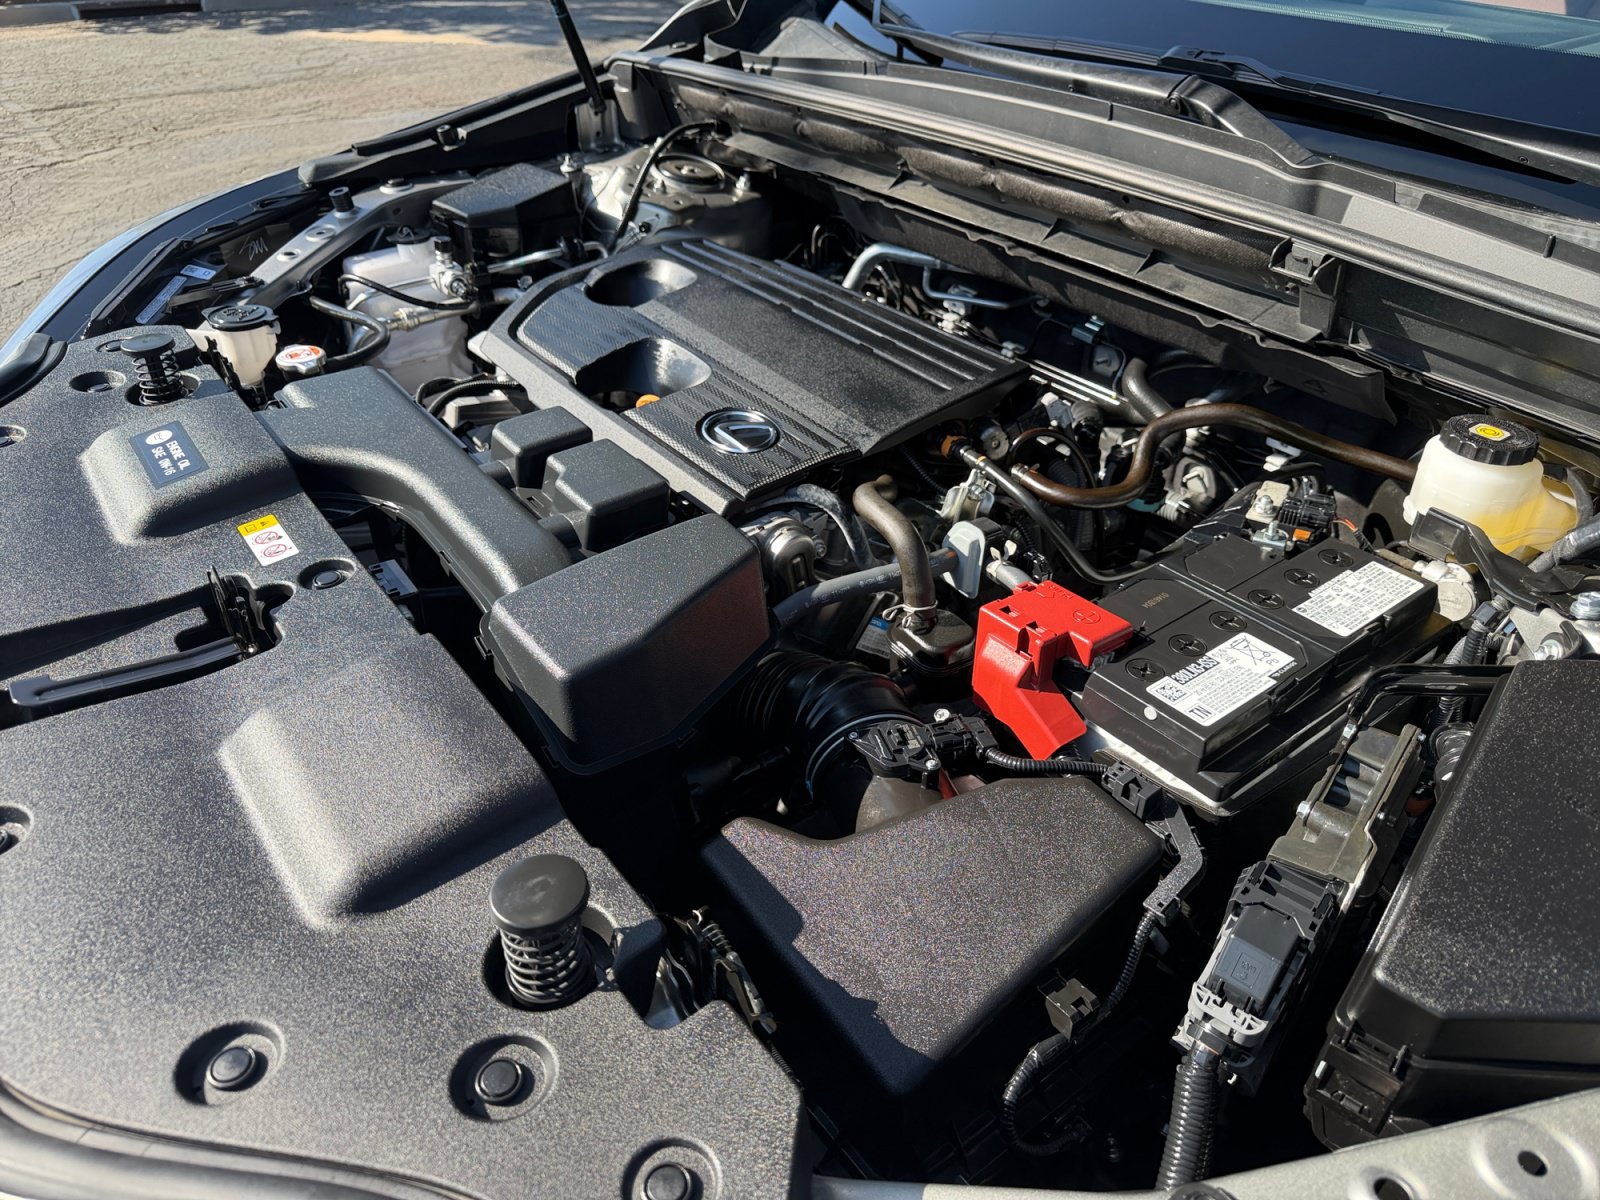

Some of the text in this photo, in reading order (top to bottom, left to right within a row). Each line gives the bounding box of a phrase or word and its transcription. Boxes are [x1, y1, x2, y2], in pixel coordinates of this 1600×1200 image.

[151, 446, 177, 476] SAE 0W-16
[165, 440, 191, 471] ENGINE OIL
[1188, 705, 1213, 720] TN
